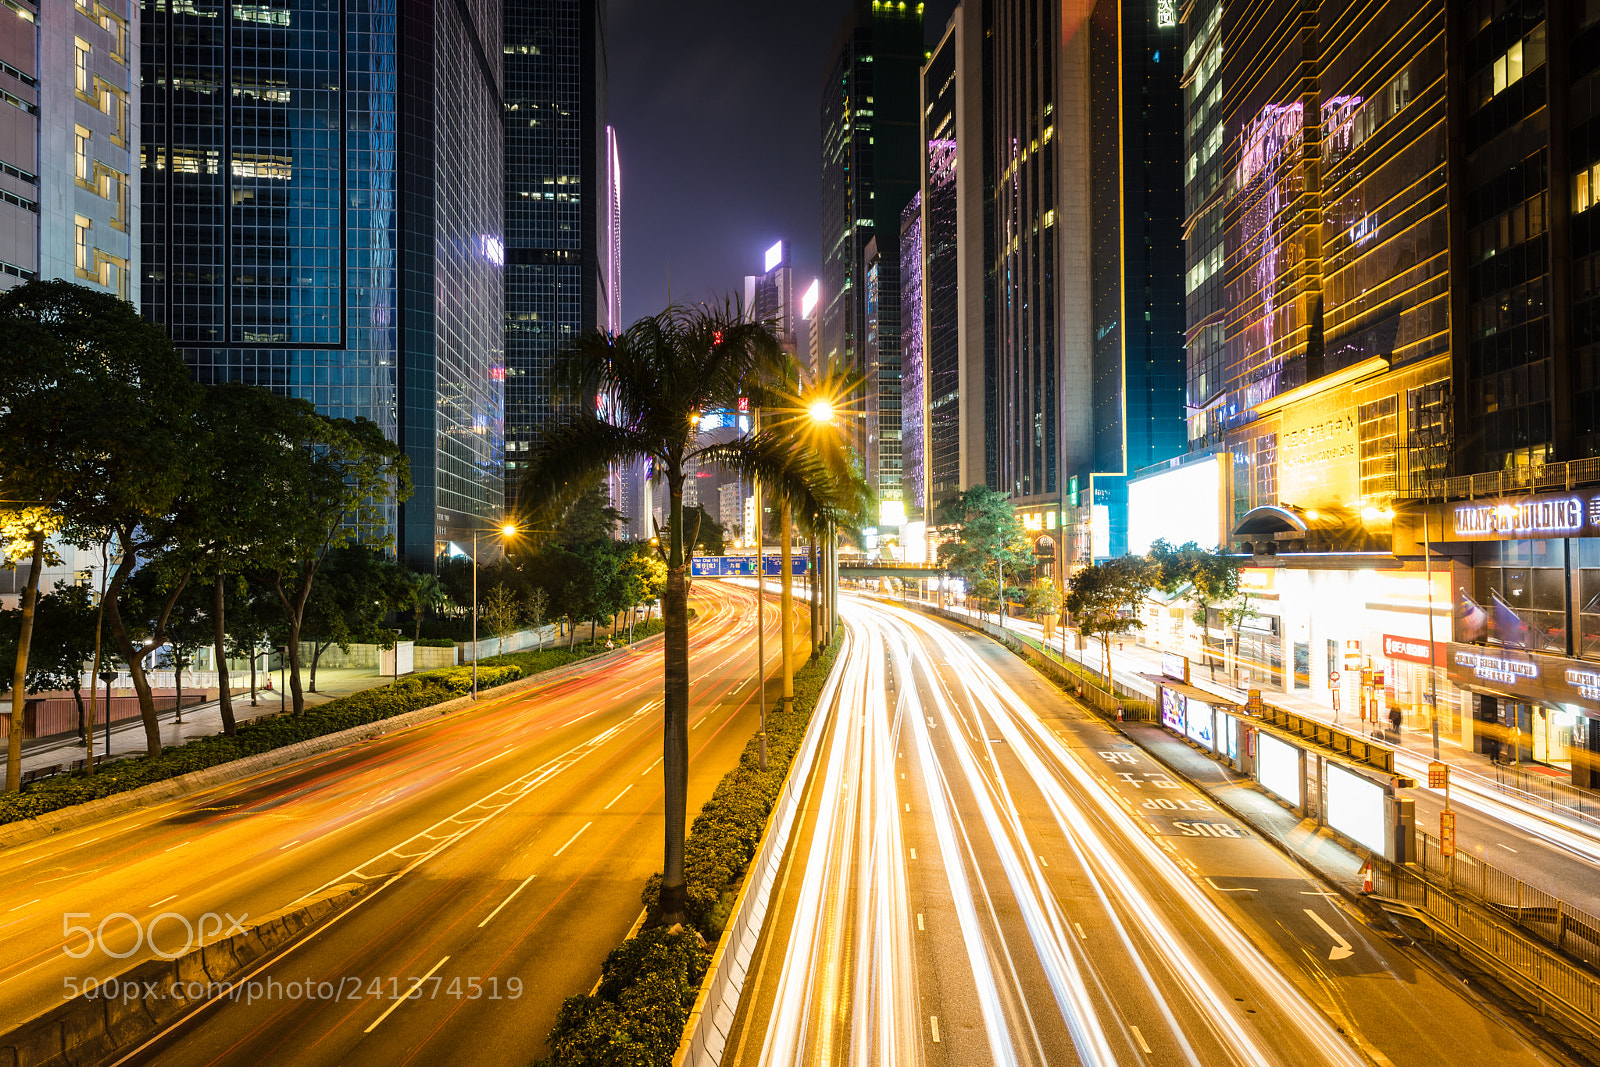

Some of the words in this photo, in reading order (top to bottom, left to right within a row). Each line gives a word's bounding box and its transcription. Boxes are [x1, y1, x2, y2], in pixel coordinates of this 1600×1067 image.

[1453, 507, 1509, 532] MALAYSIA
[1512, 500, 1581, 529] BUILDING
[1508, 662, 1535, 676] MALAYSIA
[1565, 670, 1595, 686] MALAYSIA
[1143, 799, 1214, 811] STOP
[1172, 821, 1241, 838] BUS
